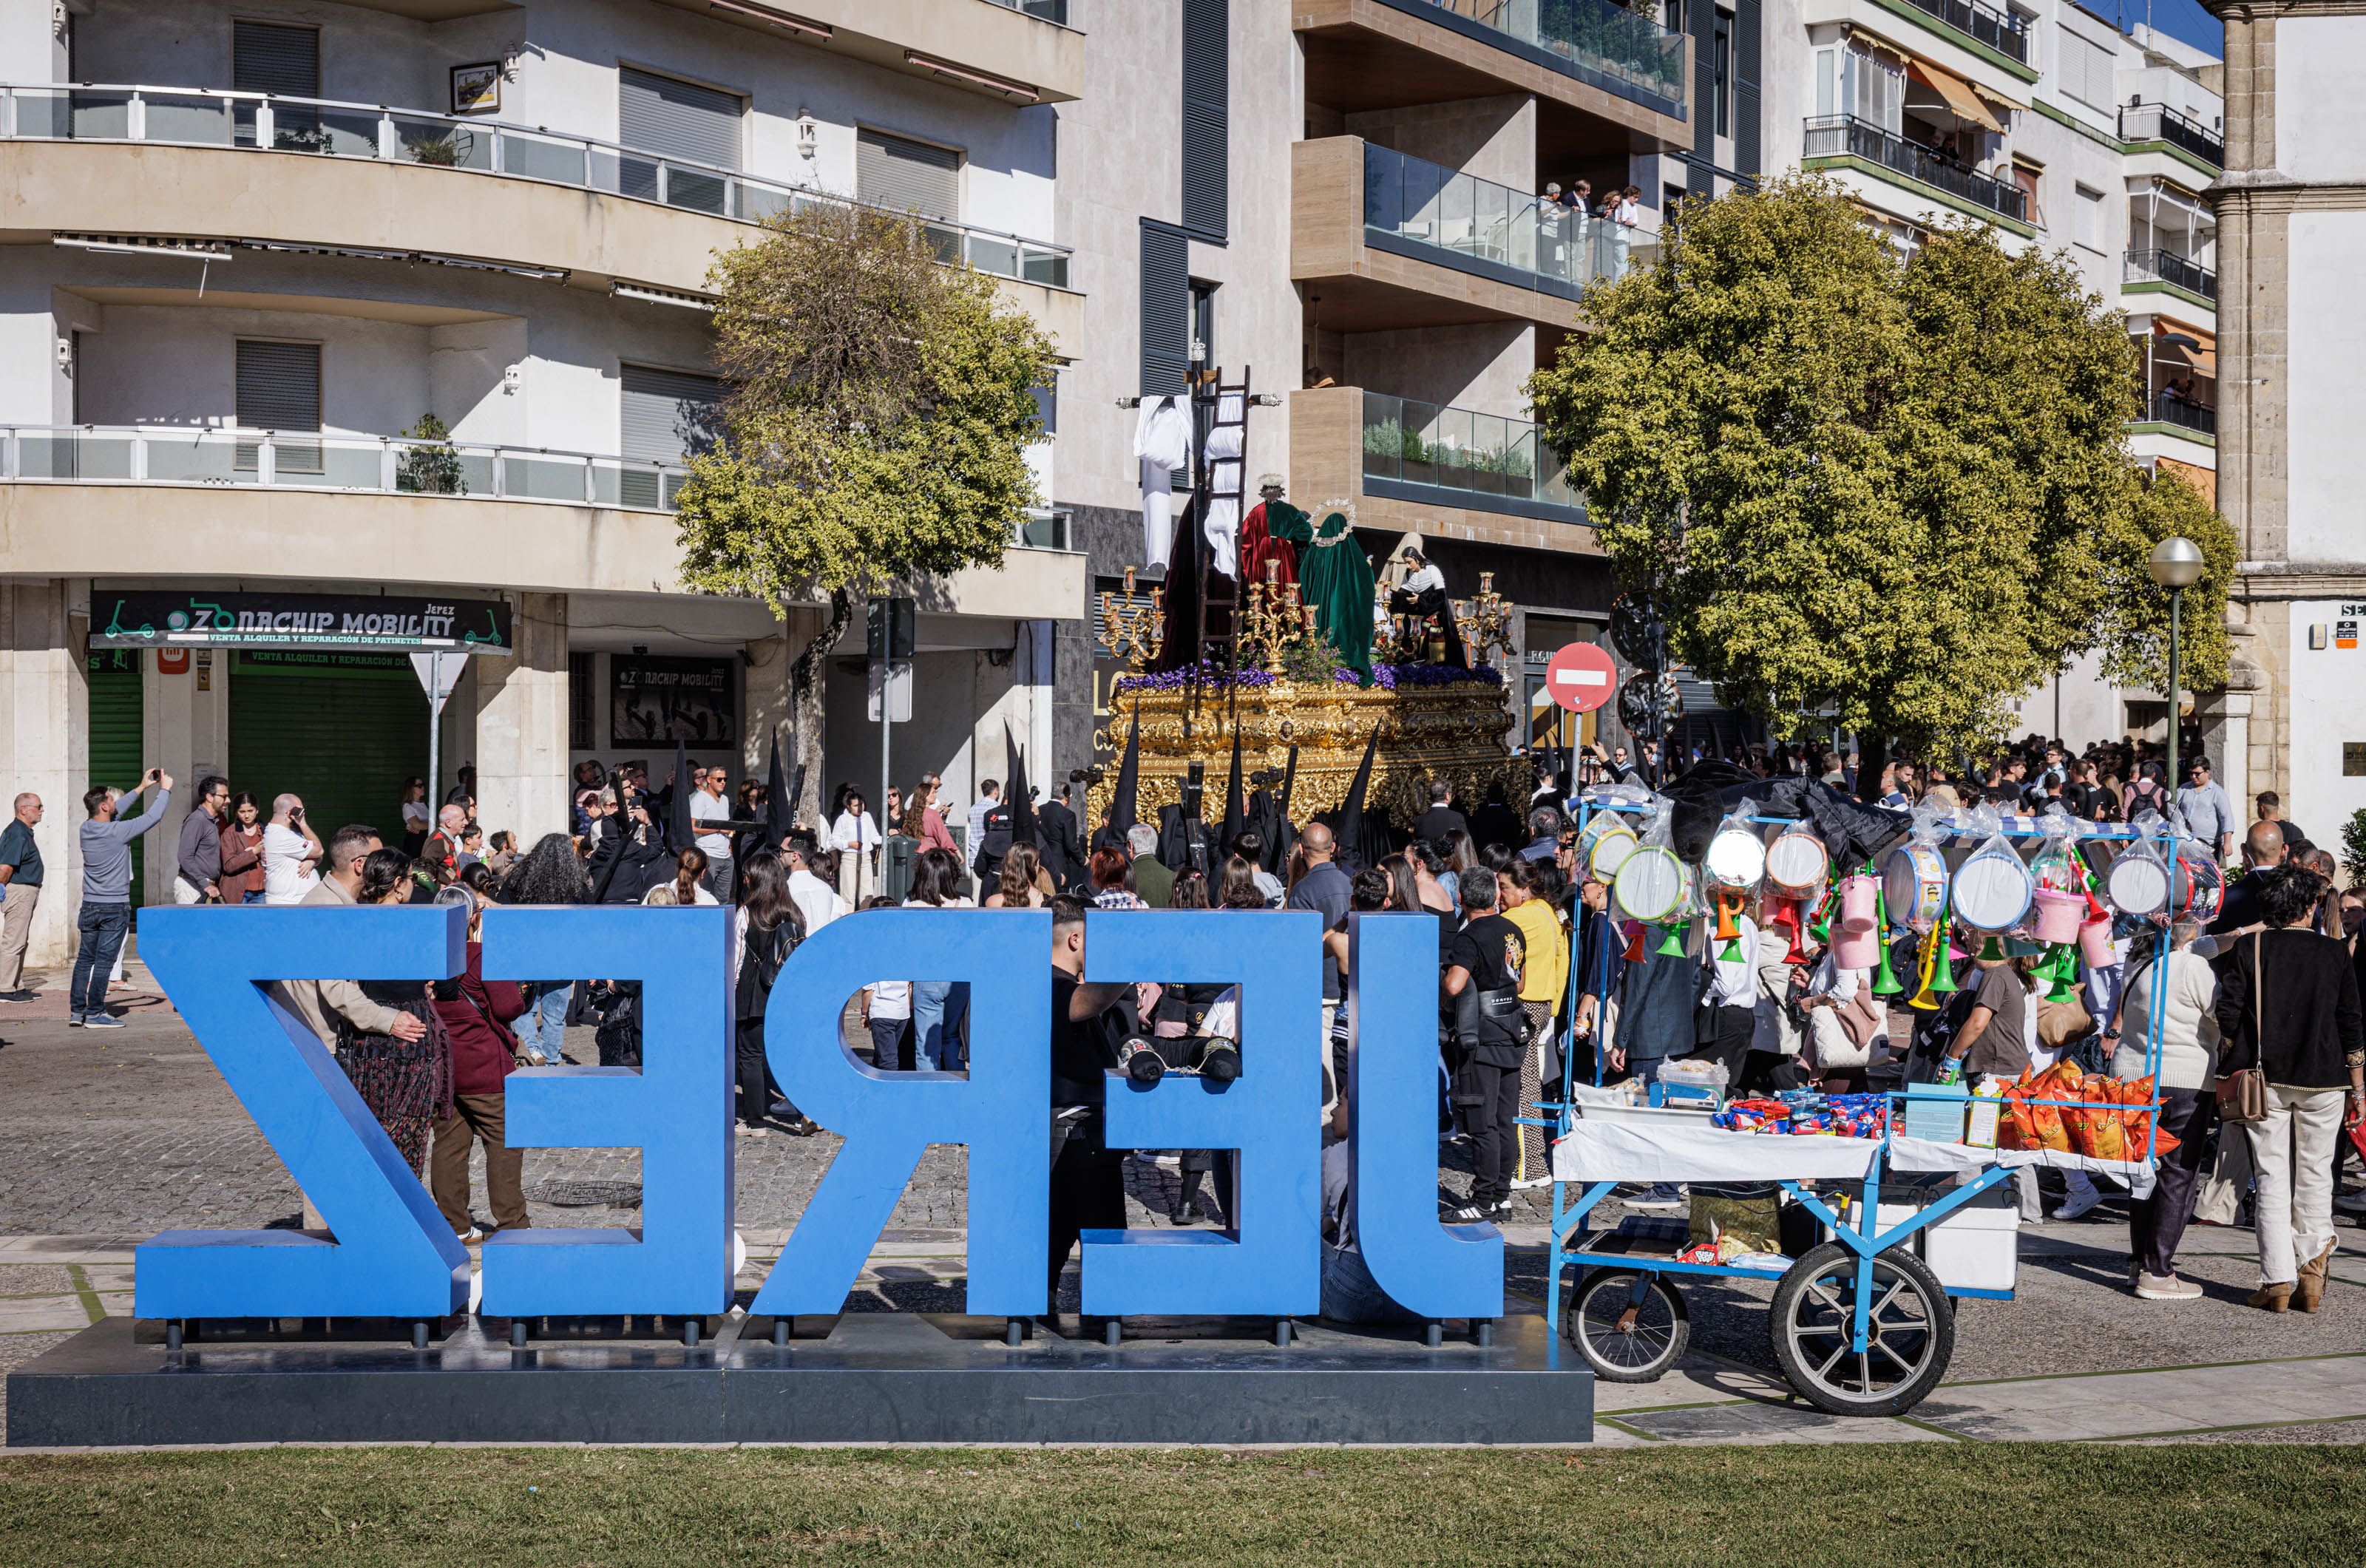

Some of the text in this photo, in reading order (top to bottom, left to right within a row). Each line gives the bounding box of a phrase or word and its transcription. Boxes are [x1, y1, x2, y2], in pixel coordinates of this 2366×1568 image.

[341, 612, 455, 637] MOBILITY
[209, 634, 241, 642] VENTA
[245, 634, 290, 642] ALQUILER
[302, 634, 361, 644] REPARACIÓN
[252, 652, 280, 662] VENTA
[284, 653, 328, 663] ALQUILER
[331, 656, 337, 664] Y
[339, 654, 393, 665] REPARACIÓN
[394, 658, 406, 666] DE
[682, 673, 725, 687] MOBILITY
